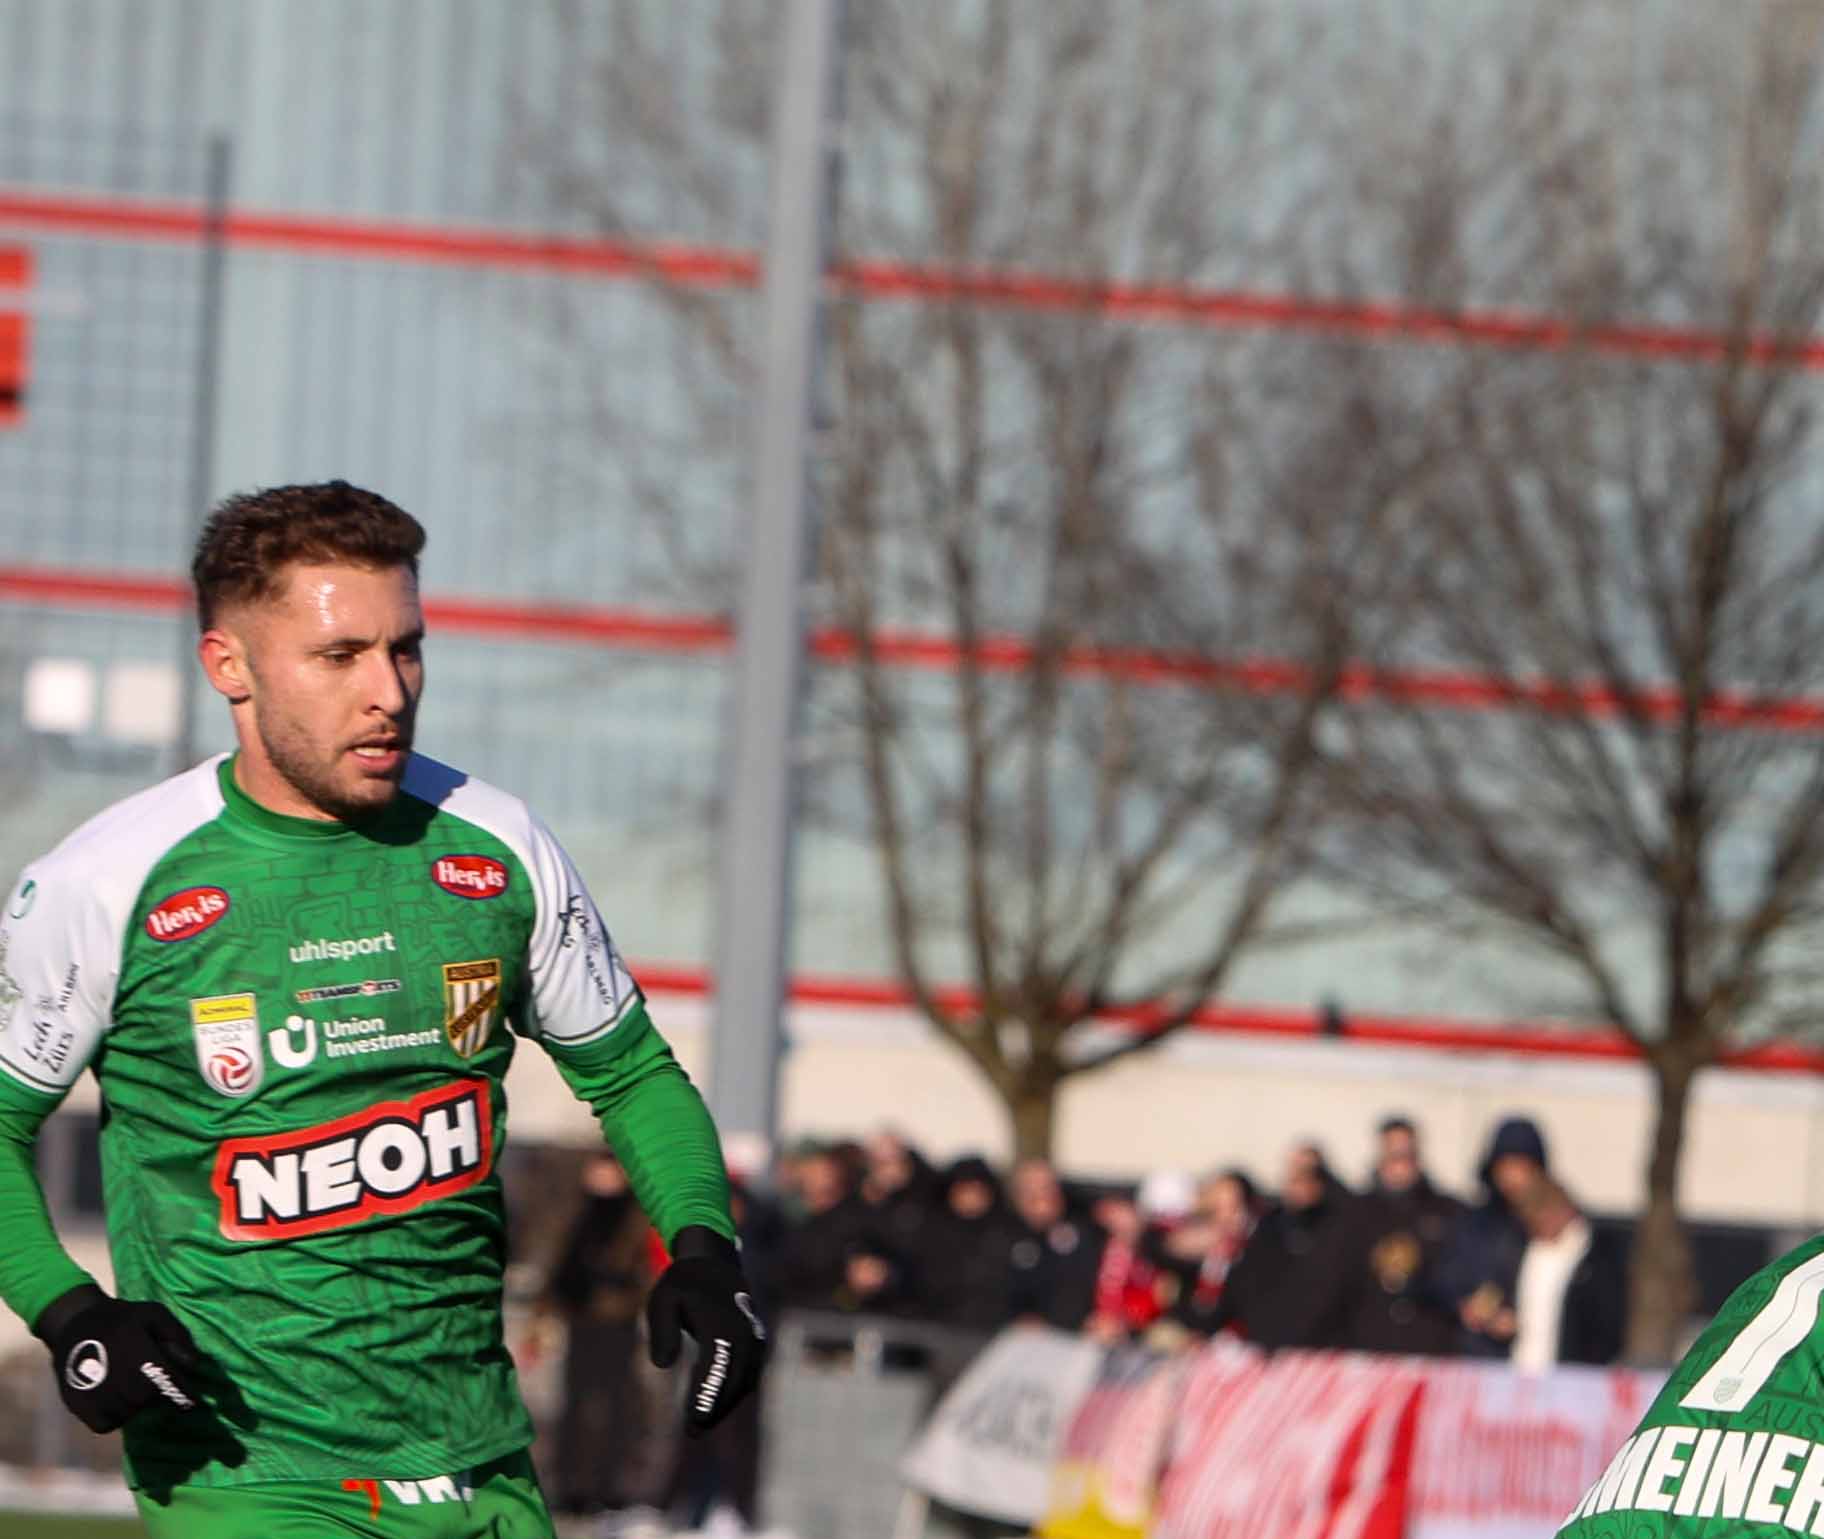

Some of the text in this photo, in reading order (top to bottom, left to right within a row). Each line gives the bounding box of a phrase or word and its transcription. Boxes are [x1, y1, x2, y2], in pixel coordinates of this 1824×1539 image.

[437, 859, 505, 891] Hervis
[148, 893, 226, 936] Hervis
[289, 931, 397, 963] uhlsport
[321, 1016, 386, 1039] Union
[325, 1028, 441, 1058] Investment
[232, 1099, 480, 1220] NEOH
[695, 1338, 732, 1413] uhlsport
